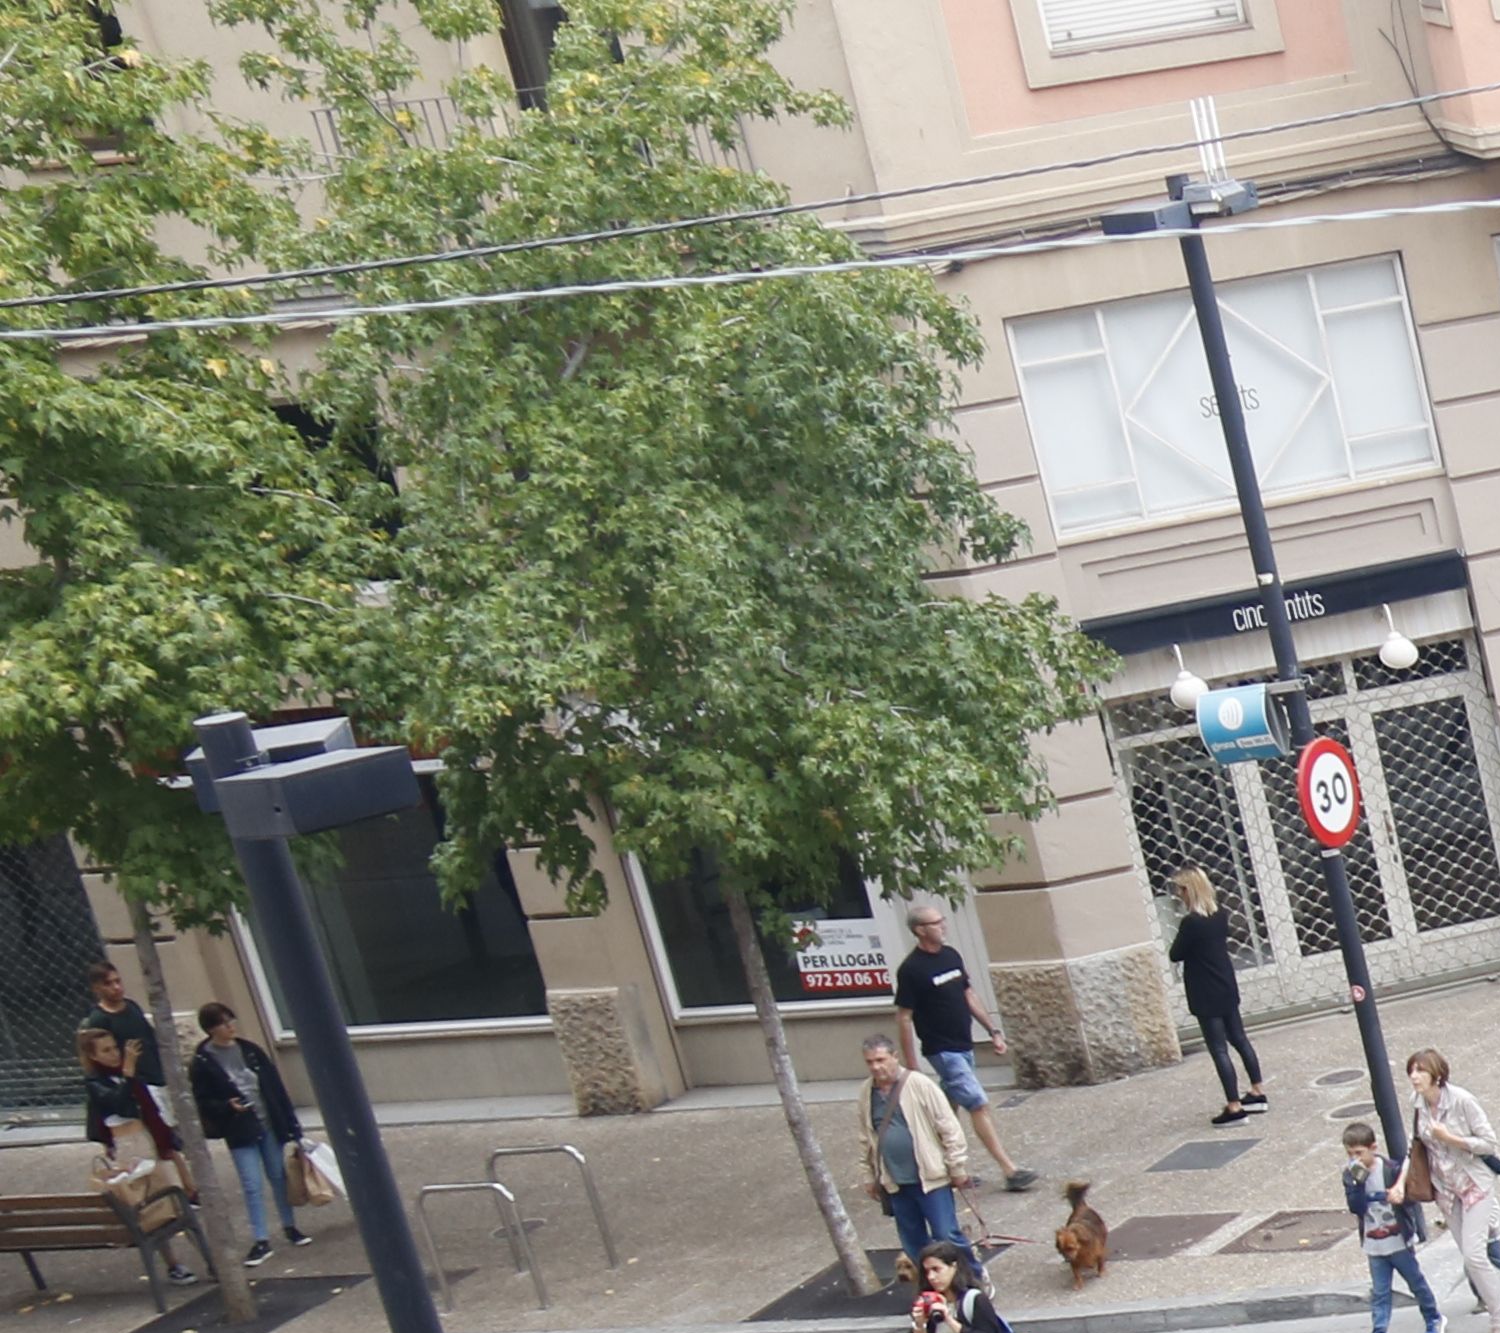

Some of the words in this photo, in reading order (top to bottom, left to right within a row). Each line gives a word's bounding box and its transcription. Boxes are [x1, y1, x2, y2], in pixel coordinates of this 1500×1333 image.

[1232, 589, 1326, 633] cincntits
[1316, 771, 1348, 814] 30
[802, 953, 829, 969] PER
[831, 951, 887, 968] LLOGAR
[807, 973, 833, 988] 972
[836, 972, 852, 987] 20
[854, 971, 872, 986] 06
[875, 970, 891, 985] 16
